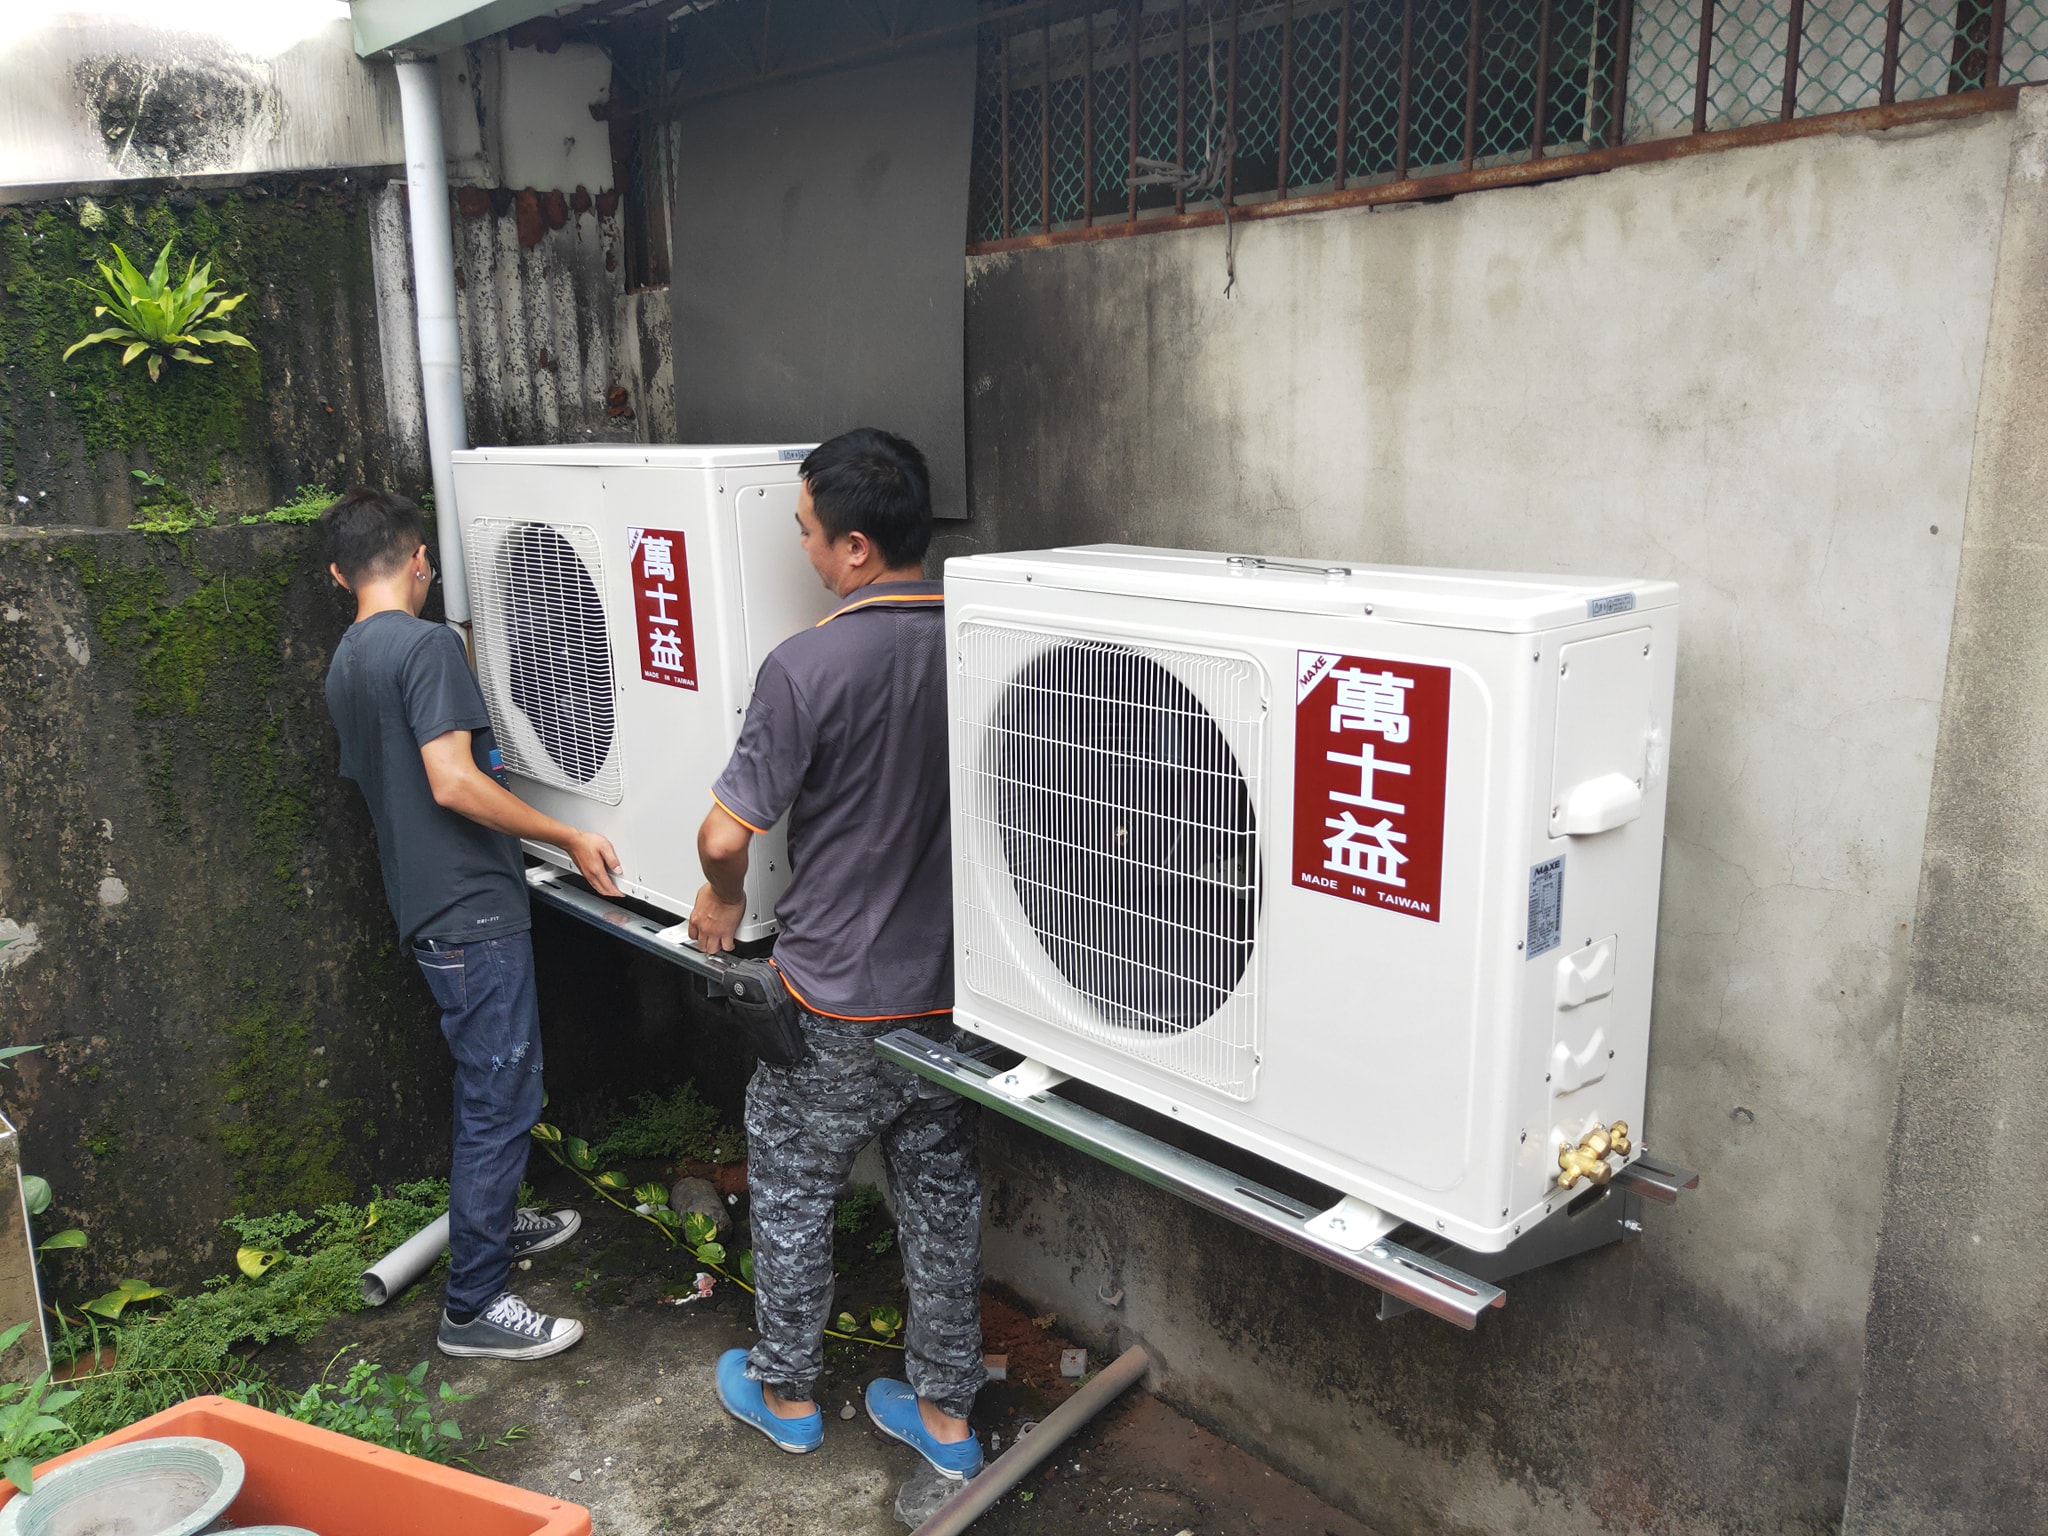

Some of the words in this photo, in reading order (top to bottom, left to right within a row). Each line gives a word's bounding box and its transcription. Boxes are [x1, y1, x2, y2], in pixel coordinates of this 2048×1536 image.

[641, 535, 684, 672] 萬士益
[644, 670, 660, 679] MADE
[674, 676, 695, 686] TAIWAN
[1299, 655, 1327, 690] MAXE
[1323, 667, 1414, 887] 萬士益
[1535, 861, 1560, 876] MAXE
[1301, 872, 1338, 889] MADE
[1352, 885, 1366, 897] IN
[1377, 891, 1431, 913] TAIWAN
[477, 916, 499, 924] DRI-FIT
